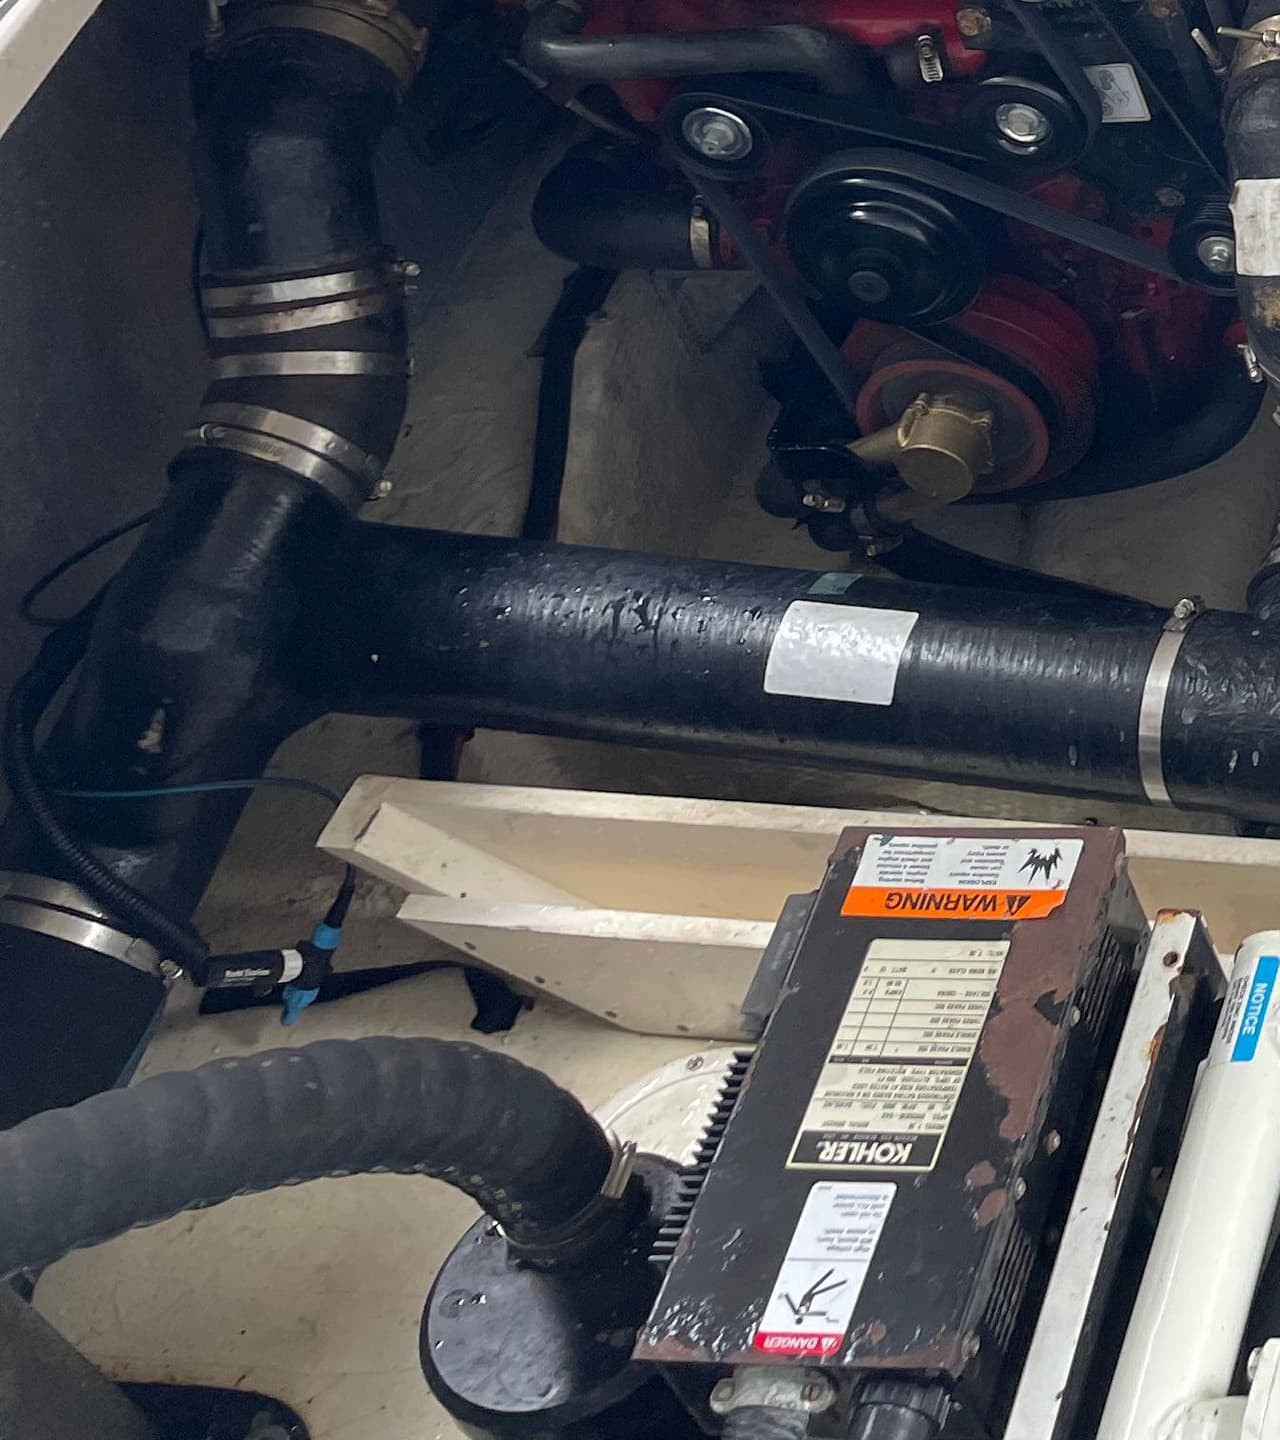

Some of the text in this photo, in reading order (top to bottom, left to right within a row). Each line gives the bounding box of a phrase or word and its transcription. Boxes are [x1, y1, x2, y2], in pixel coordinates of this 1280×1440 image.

[885, 893, 999, 910] WARNING
[1242, 982, 1268, 1035] NOTICE
[819, 1141, 912, 1163] KOHLER
[763, 1336, 819, 1349] DANGER
